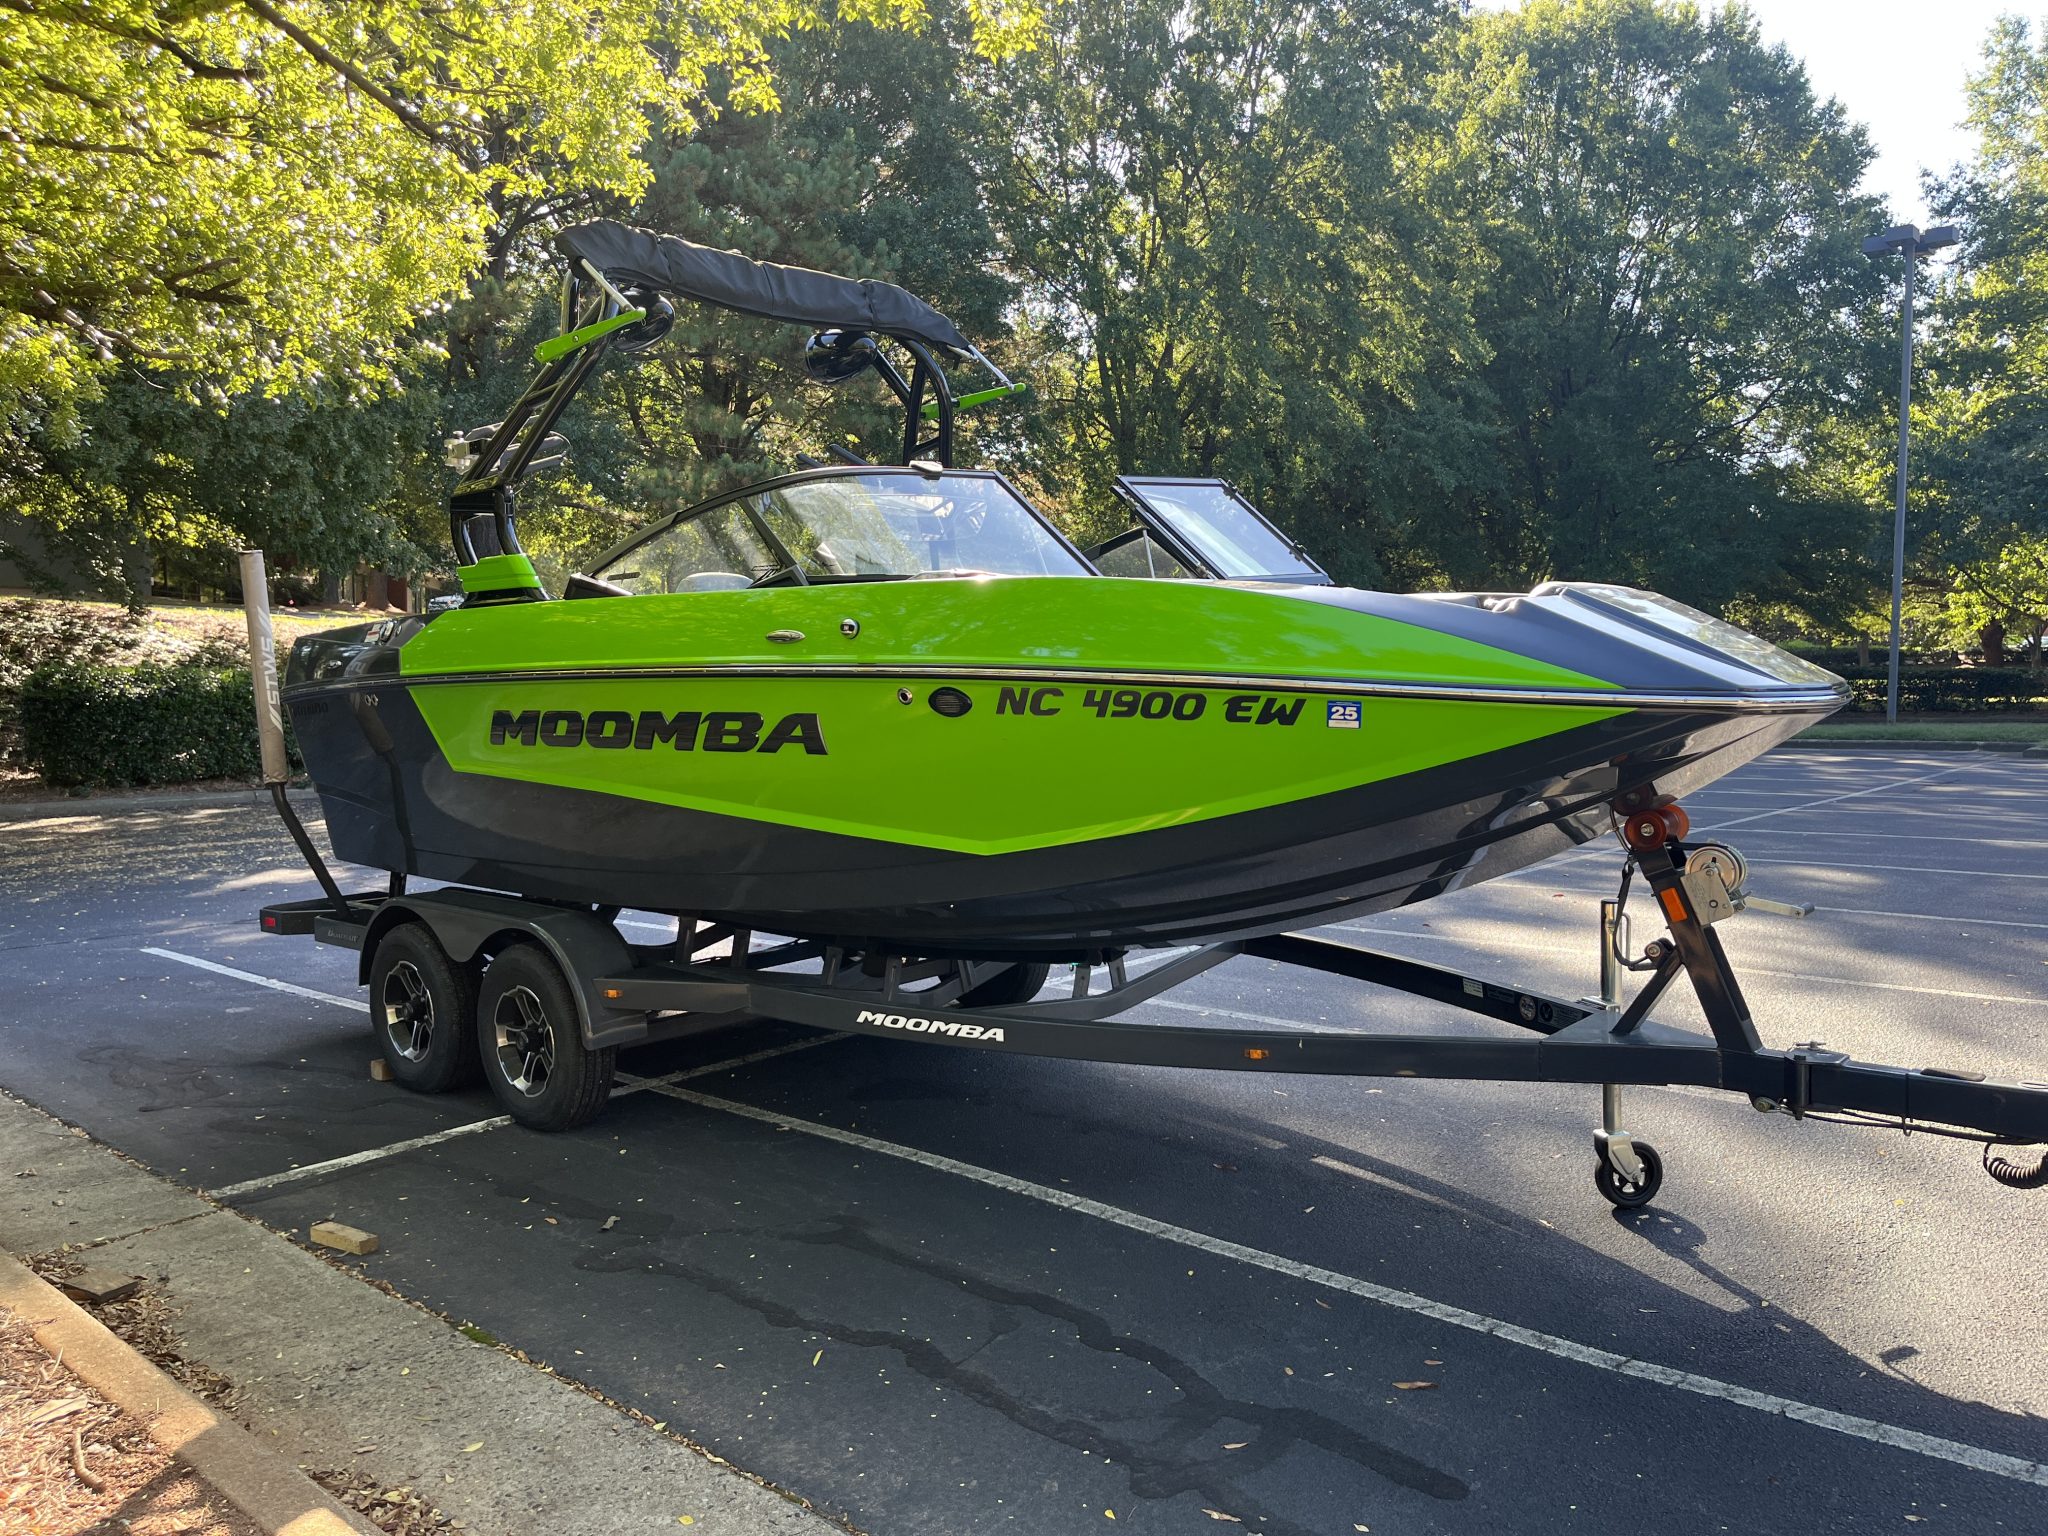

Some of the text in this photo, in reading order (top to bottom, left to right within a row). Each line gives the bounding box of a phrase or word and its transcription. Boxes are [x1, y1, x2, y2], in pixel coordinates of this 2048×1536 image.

[996, 686, 1306, 727] NC 4900 EW
[1330, 706, 1358, 720] 25
[490, 709, 829, 756] MOOMBA
[856, 1010, 1006, 1043] MOOMBA
